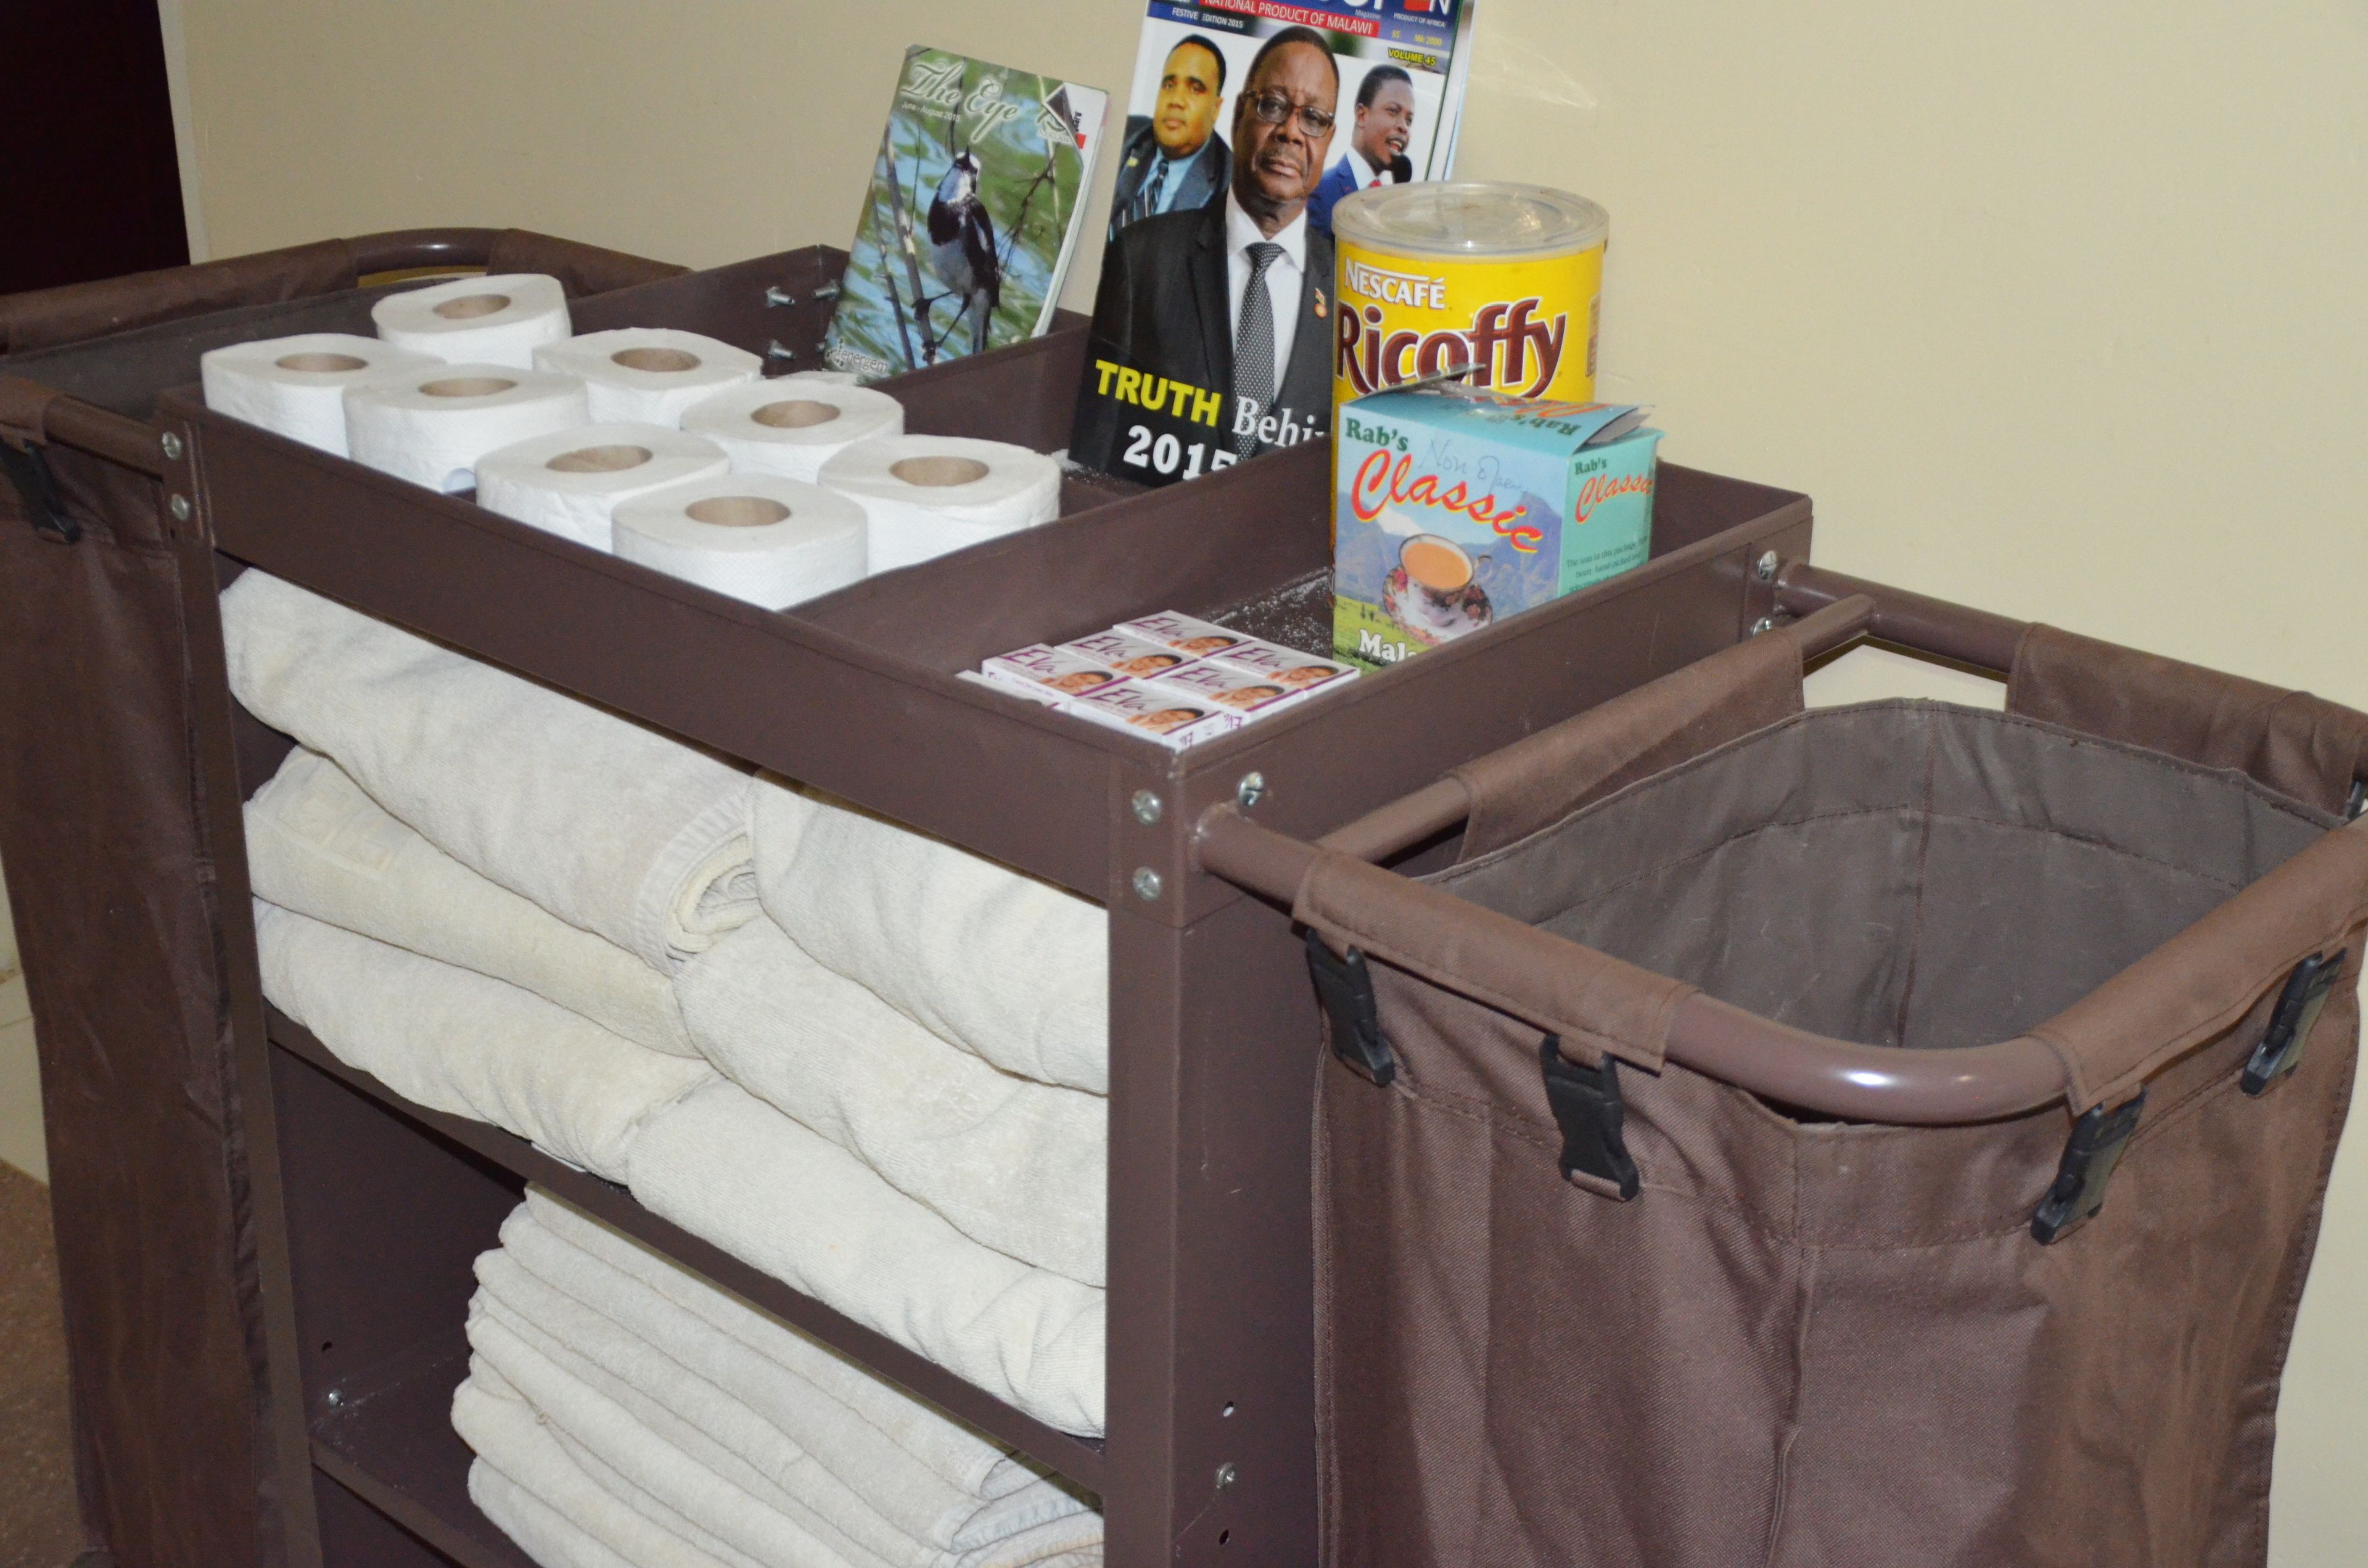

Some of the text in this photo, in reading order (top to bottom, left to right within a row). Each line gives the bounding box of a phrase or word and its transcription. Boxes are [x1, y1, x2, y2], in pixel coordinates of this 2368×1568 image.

[1172, 7, 1244, 28] FESTIVE EDITION 2015
[1259, 2, 1309, 22] PRODUCT
[1310, 12, 1325, 25] OF
[1327, 15, 1372, 35] MALAWI
[1394, 12, 1417, 23] PRODUCT
[1426, 18, 1445, 28] AFRICA
[1388, 47, 1436, 66] VOLUME 45
[900, 59, 964, 105] The
[964, 77, 1019, 143] Eye
[902, 102, 917, 112] June
[920, 106, 944, 120] August
[944, 111, 961, 123] 2015
[1344, 257, 1445, 310] NESCAFÉ
[1337, 297, 1569, 400] Ricoffy
[841, 349, 889, 372] energem
[1095, 359, 1326, 447] TRUTH Behi
[1345, 417, 1409, 452] Rab's
[1575, 456, 1607, 475] Rab's
[1350, 449, 1543, 554] Classic
[1128, 617, 1183, 638] Eva
[1070, 636, 1127, 658] Eva
[1224, 647, 1281, 668] Eva
[1359, 629, 1418, 664] Mal
[998, 649, 1055, 673] Eva
[1169, 667, 1227, 688] Eva
[1087, 688, 1146, 711] Eva
